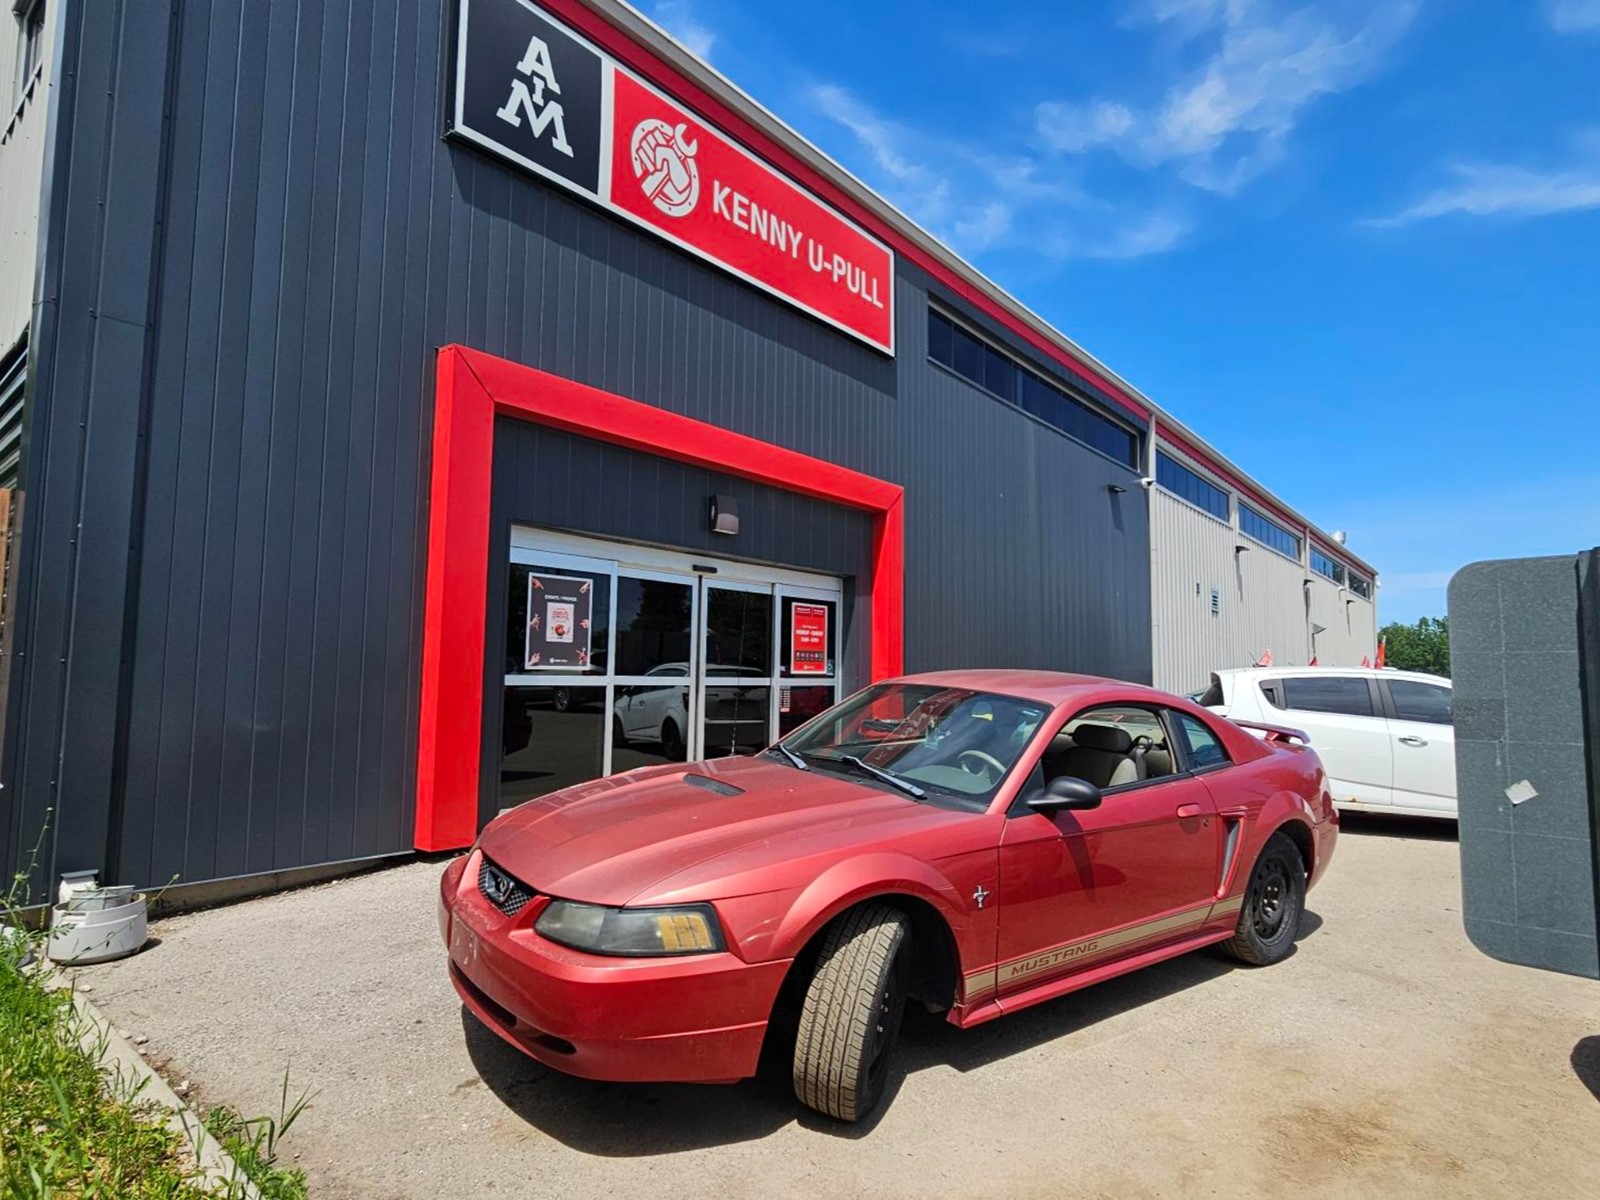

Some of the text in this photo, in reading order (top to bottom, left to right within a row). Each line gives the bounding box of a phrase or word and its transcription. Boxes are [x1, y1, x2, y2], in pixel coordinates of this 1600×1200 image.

[496, 35, 574, 158] AIM
[713, 180, 884, 309] KENNY U-PULL
[1011, 941, 1099, 976] MUSTANG
